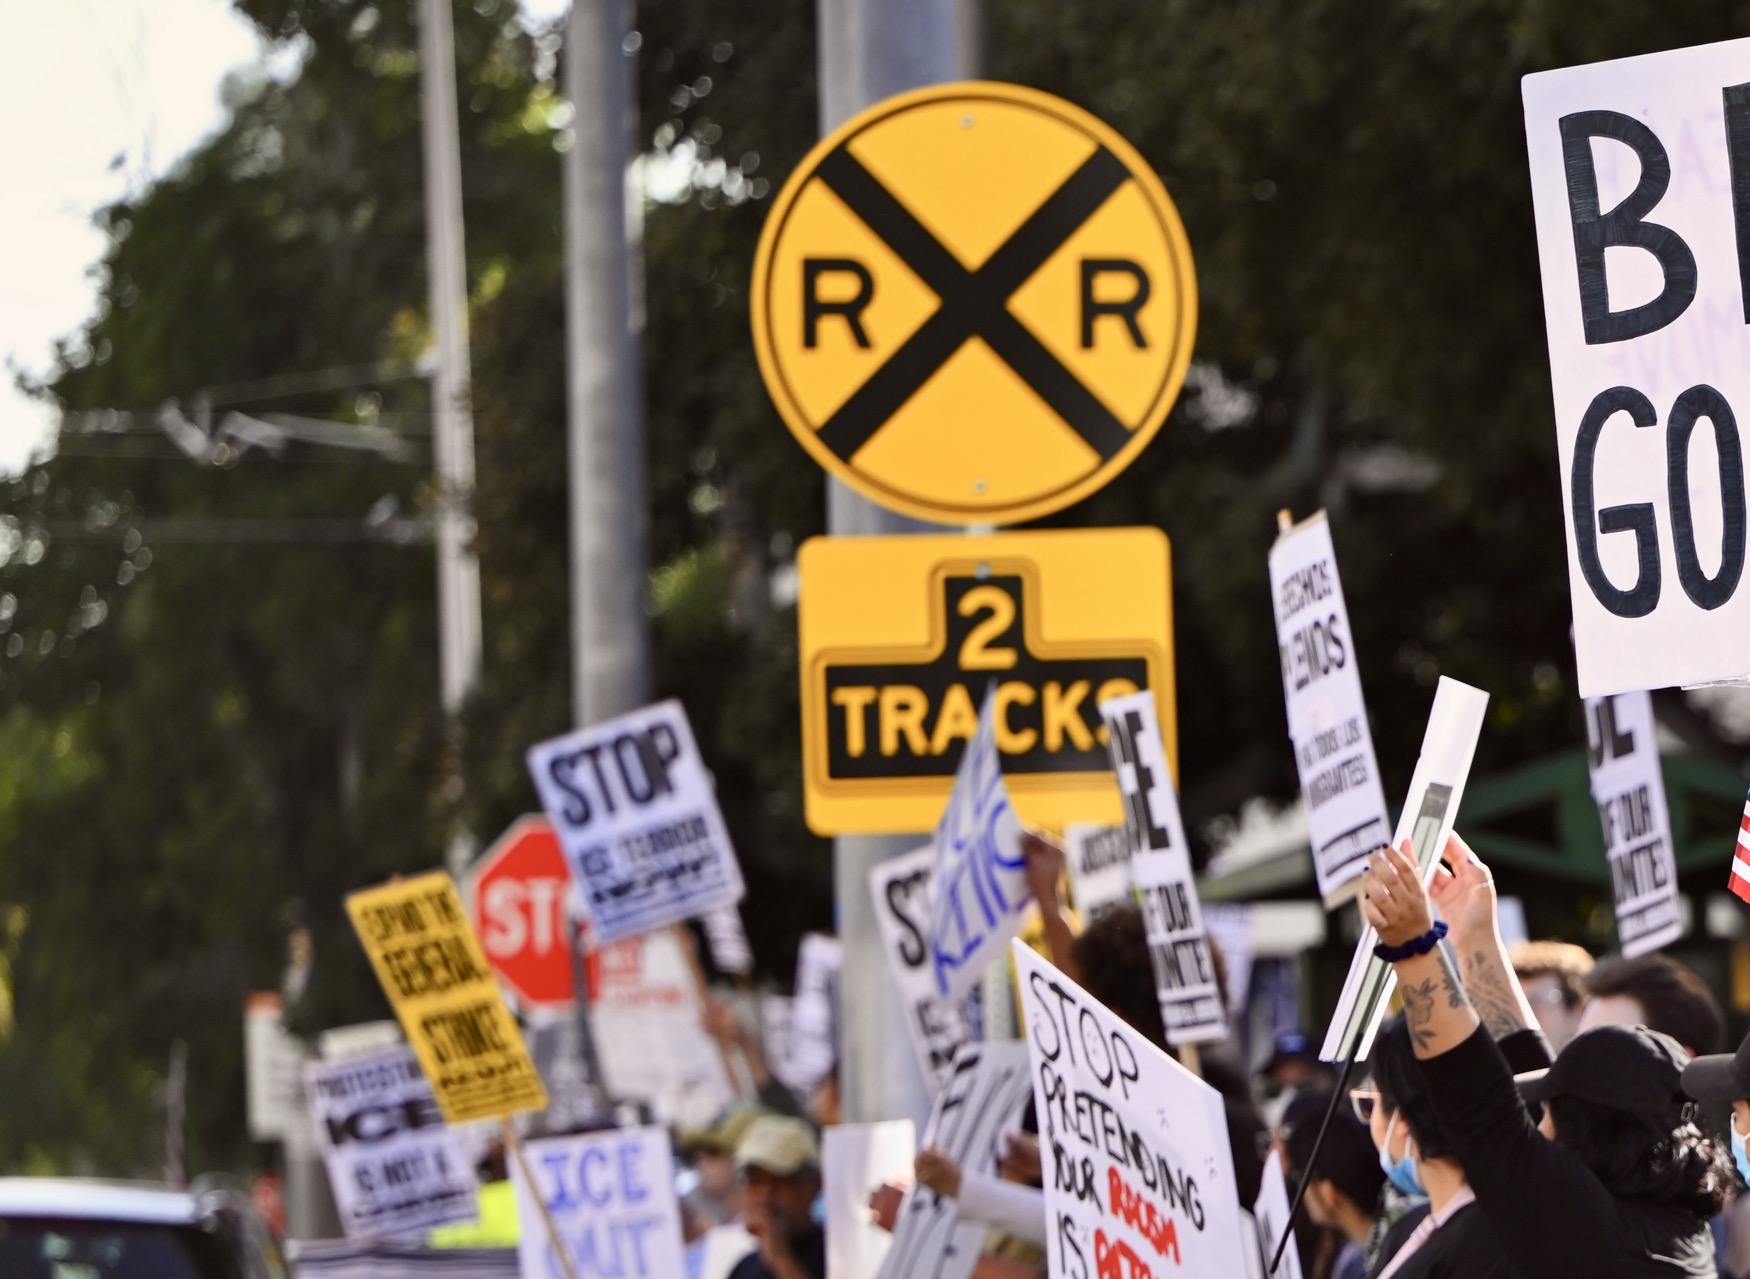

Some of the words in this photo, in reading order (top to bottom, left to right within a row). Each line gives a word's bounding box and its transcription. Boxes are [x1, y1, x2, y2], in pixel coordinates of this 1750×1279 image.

[800, 257, 876, 351] R
[1079, 258, 1153, 352] R
[957, 586, 1018, 671] 2
[549, 721, 681, 831] STOP
[484, 875, 576, 958] ST
[1029, 970, 1139, 1100] STOP
[543, 1142, 648, 1212] ICE
[1040, 1060, 1205, 1231] PRETENDING
[1047, 1134, 1103, 1215] YOUR
[1108, 1165, 1182, 1266] RACISM
